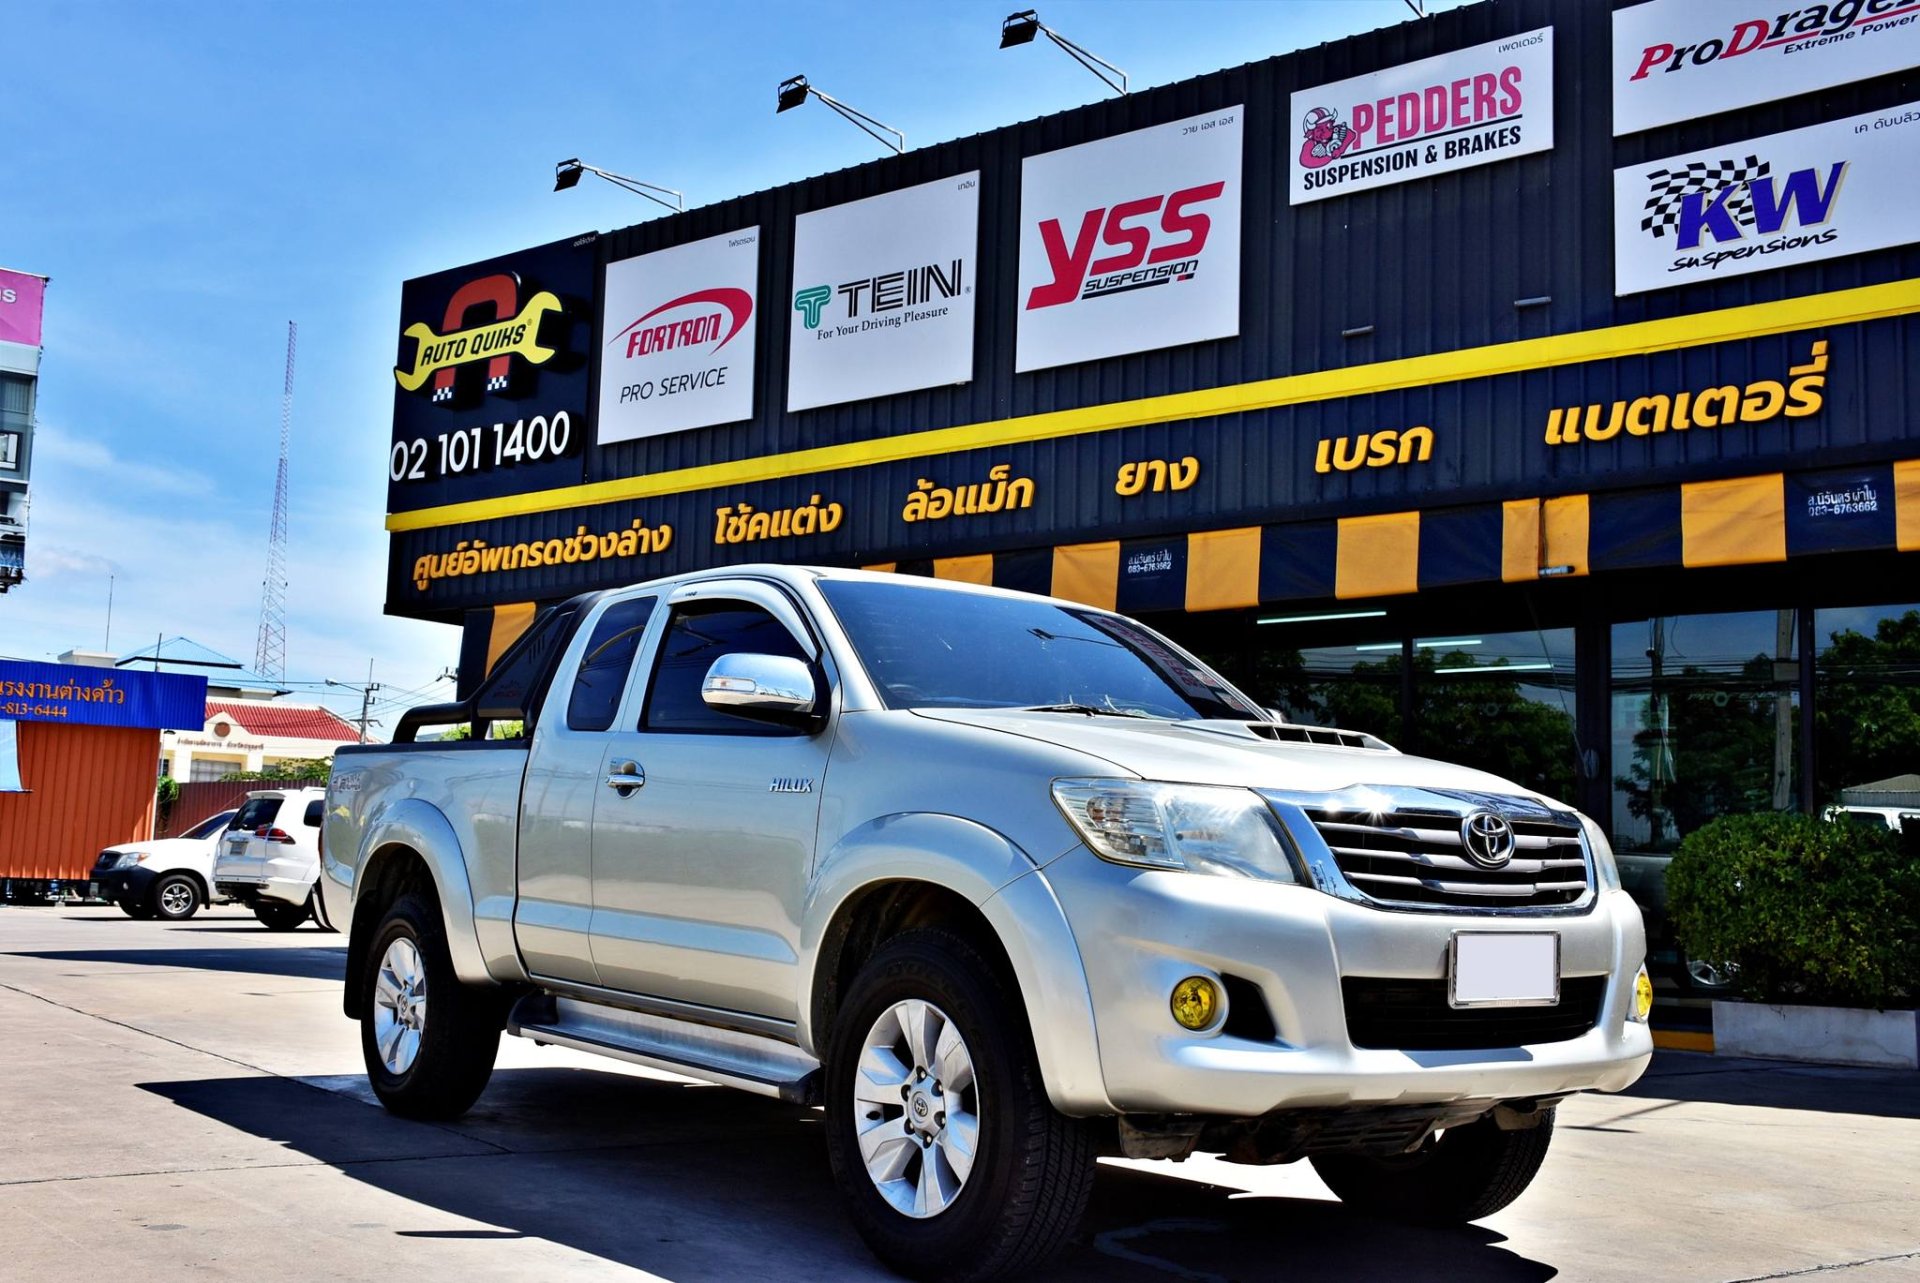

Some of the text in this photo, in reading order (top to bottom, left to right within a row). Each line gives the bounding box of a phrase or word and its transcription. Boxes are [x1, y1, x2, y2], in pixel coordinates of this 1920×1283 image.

[1783, 14, 1919, 55] Extreme Power
[1352, 66, 1523, 151] PEDDERS
[1854, 124, 1868, 134] เค
[1303, 125, 1521, 191] SUSPENSION & BRAKES
[1676, 160, 1850, 250] KW
[1026, 181, 1226, 311] YSS
[1668, 228, 1839, 273] suspensions
[838, 258, 963, 319] TEIN
[1083, 259, 1199, 293] SUSPENSION
[420, 324, 527, 368] AUTO QUIKS
[626, 313, 722, 359] FORTRON
[817, 307, 949, 341] For Your Driving Pleasure
[620, 366, 728, 404] PRO SERVICE
[390, 410, 571, 482] 02 101 1400
[412, 340, 1829, 591] ศูนย์อัพเกรดช่วงล่าง โช้คแต่ง ล้อแม็ก ยาง เบรก แบตเตอรี่
[0, 678, 124, 704] รงงานต่างด้าว
[769, 777, 814, 793] HILUX
